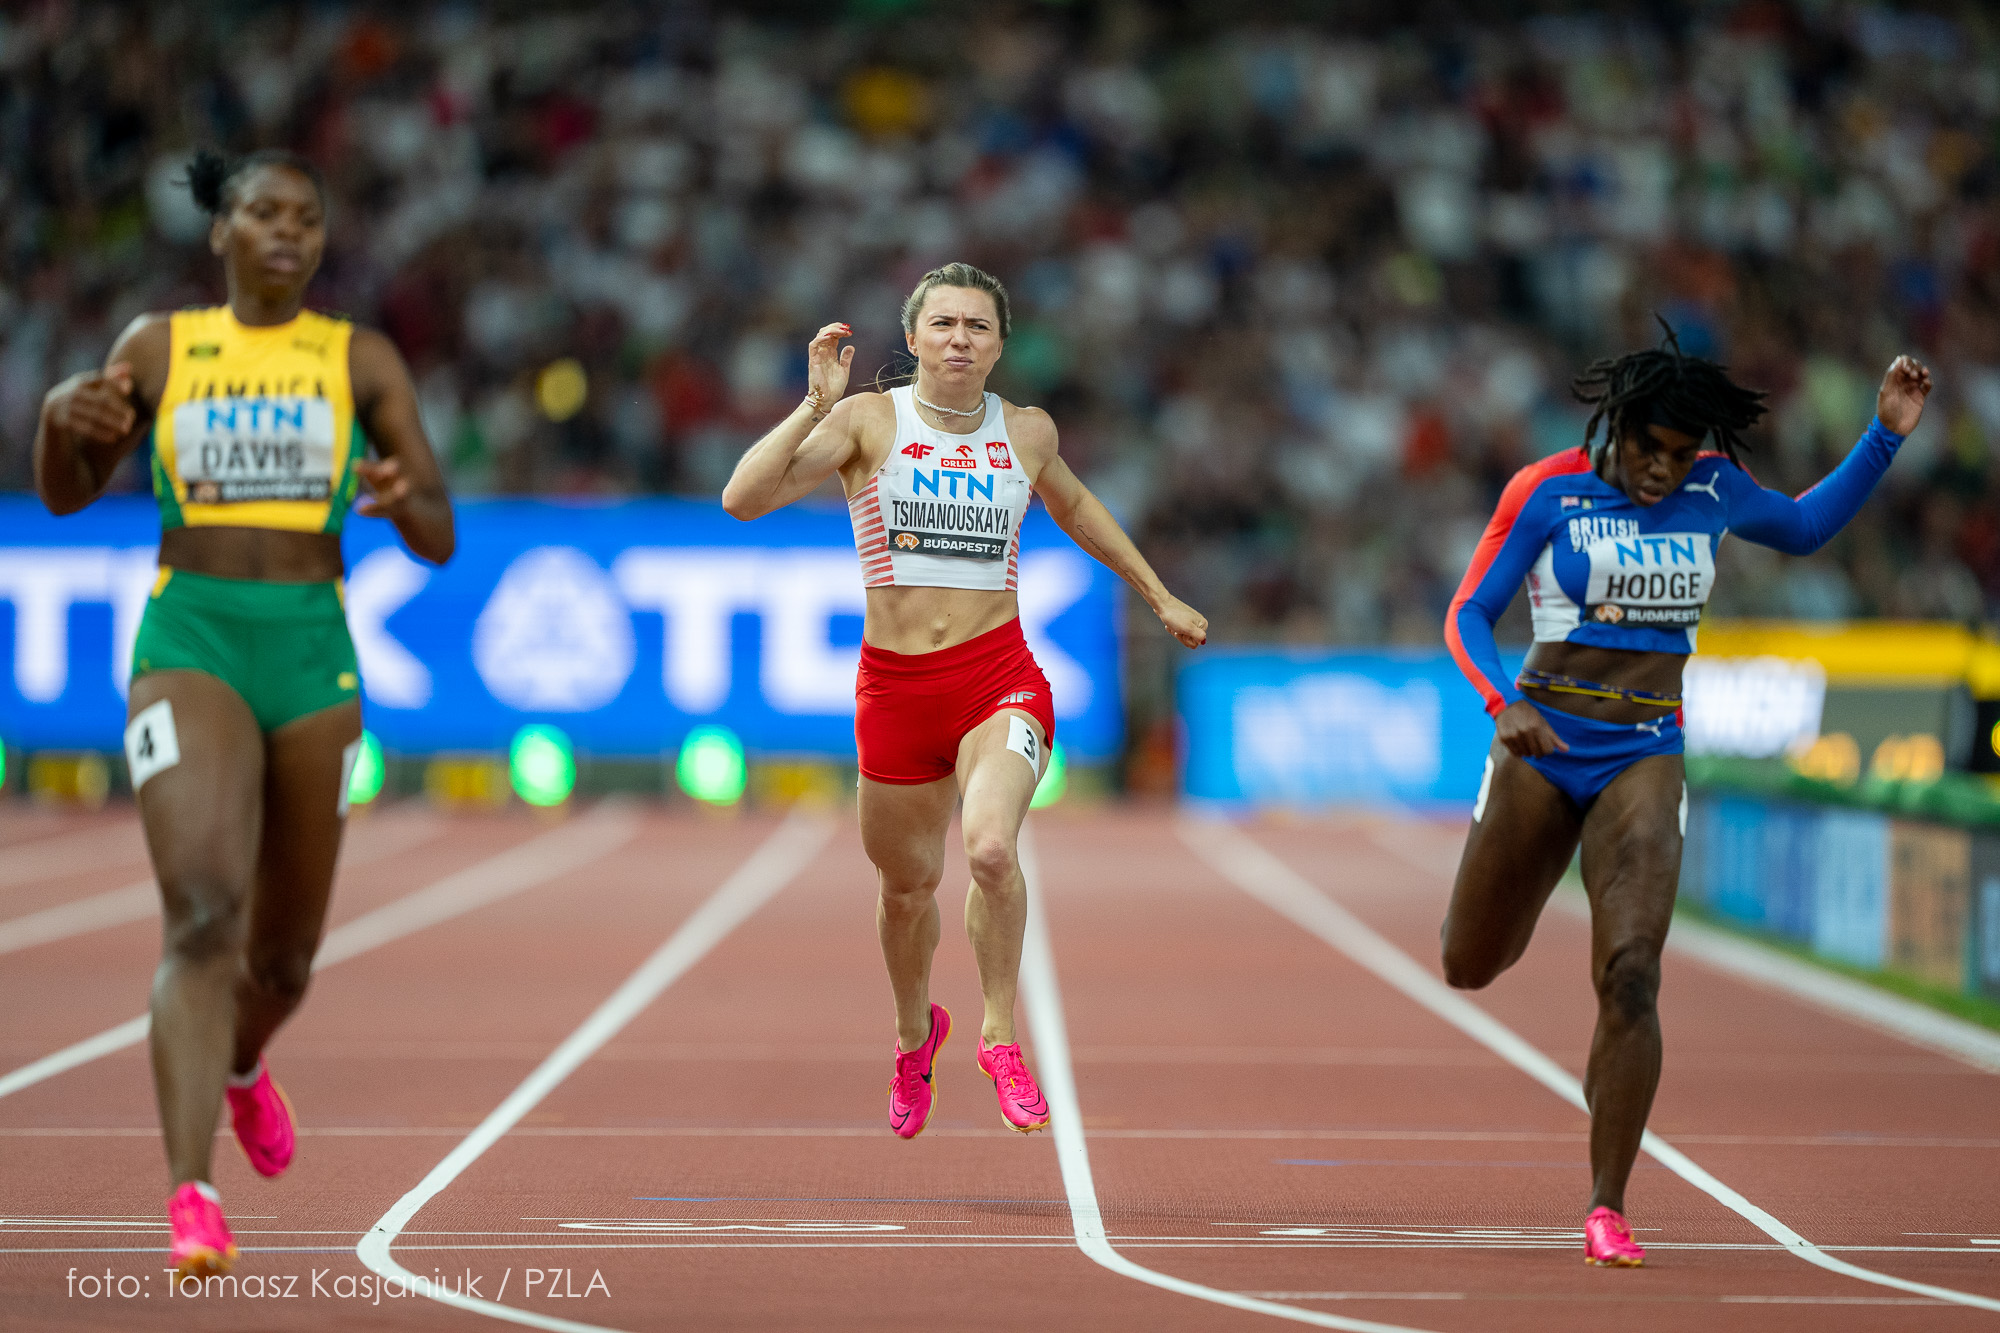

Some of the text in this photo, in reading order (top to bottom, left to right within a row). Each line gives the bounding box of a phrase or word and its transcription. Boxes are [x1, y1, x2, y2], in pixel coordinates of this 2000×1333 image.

[206, 398, 304, 432] NTN
[202, 441, 304, 476] DAVIS
[901, 442, 935, 459] 4F
[942, 459, 976, 468] ORLEN
[912, 468, 994, 502] NTN
[892, 500, 1009, 535] TSIMANOUSKAYA
[1568, 516, 1640, 538] BRITISH
[923, 538, 990, 553] BUDAPEST
[1615, 536, 1696, 568] NTN
[1606, 572, 1702, 600] HODGE
[137, 723, 155, 759] 4
[1023, 728, 1036, 760] 3
